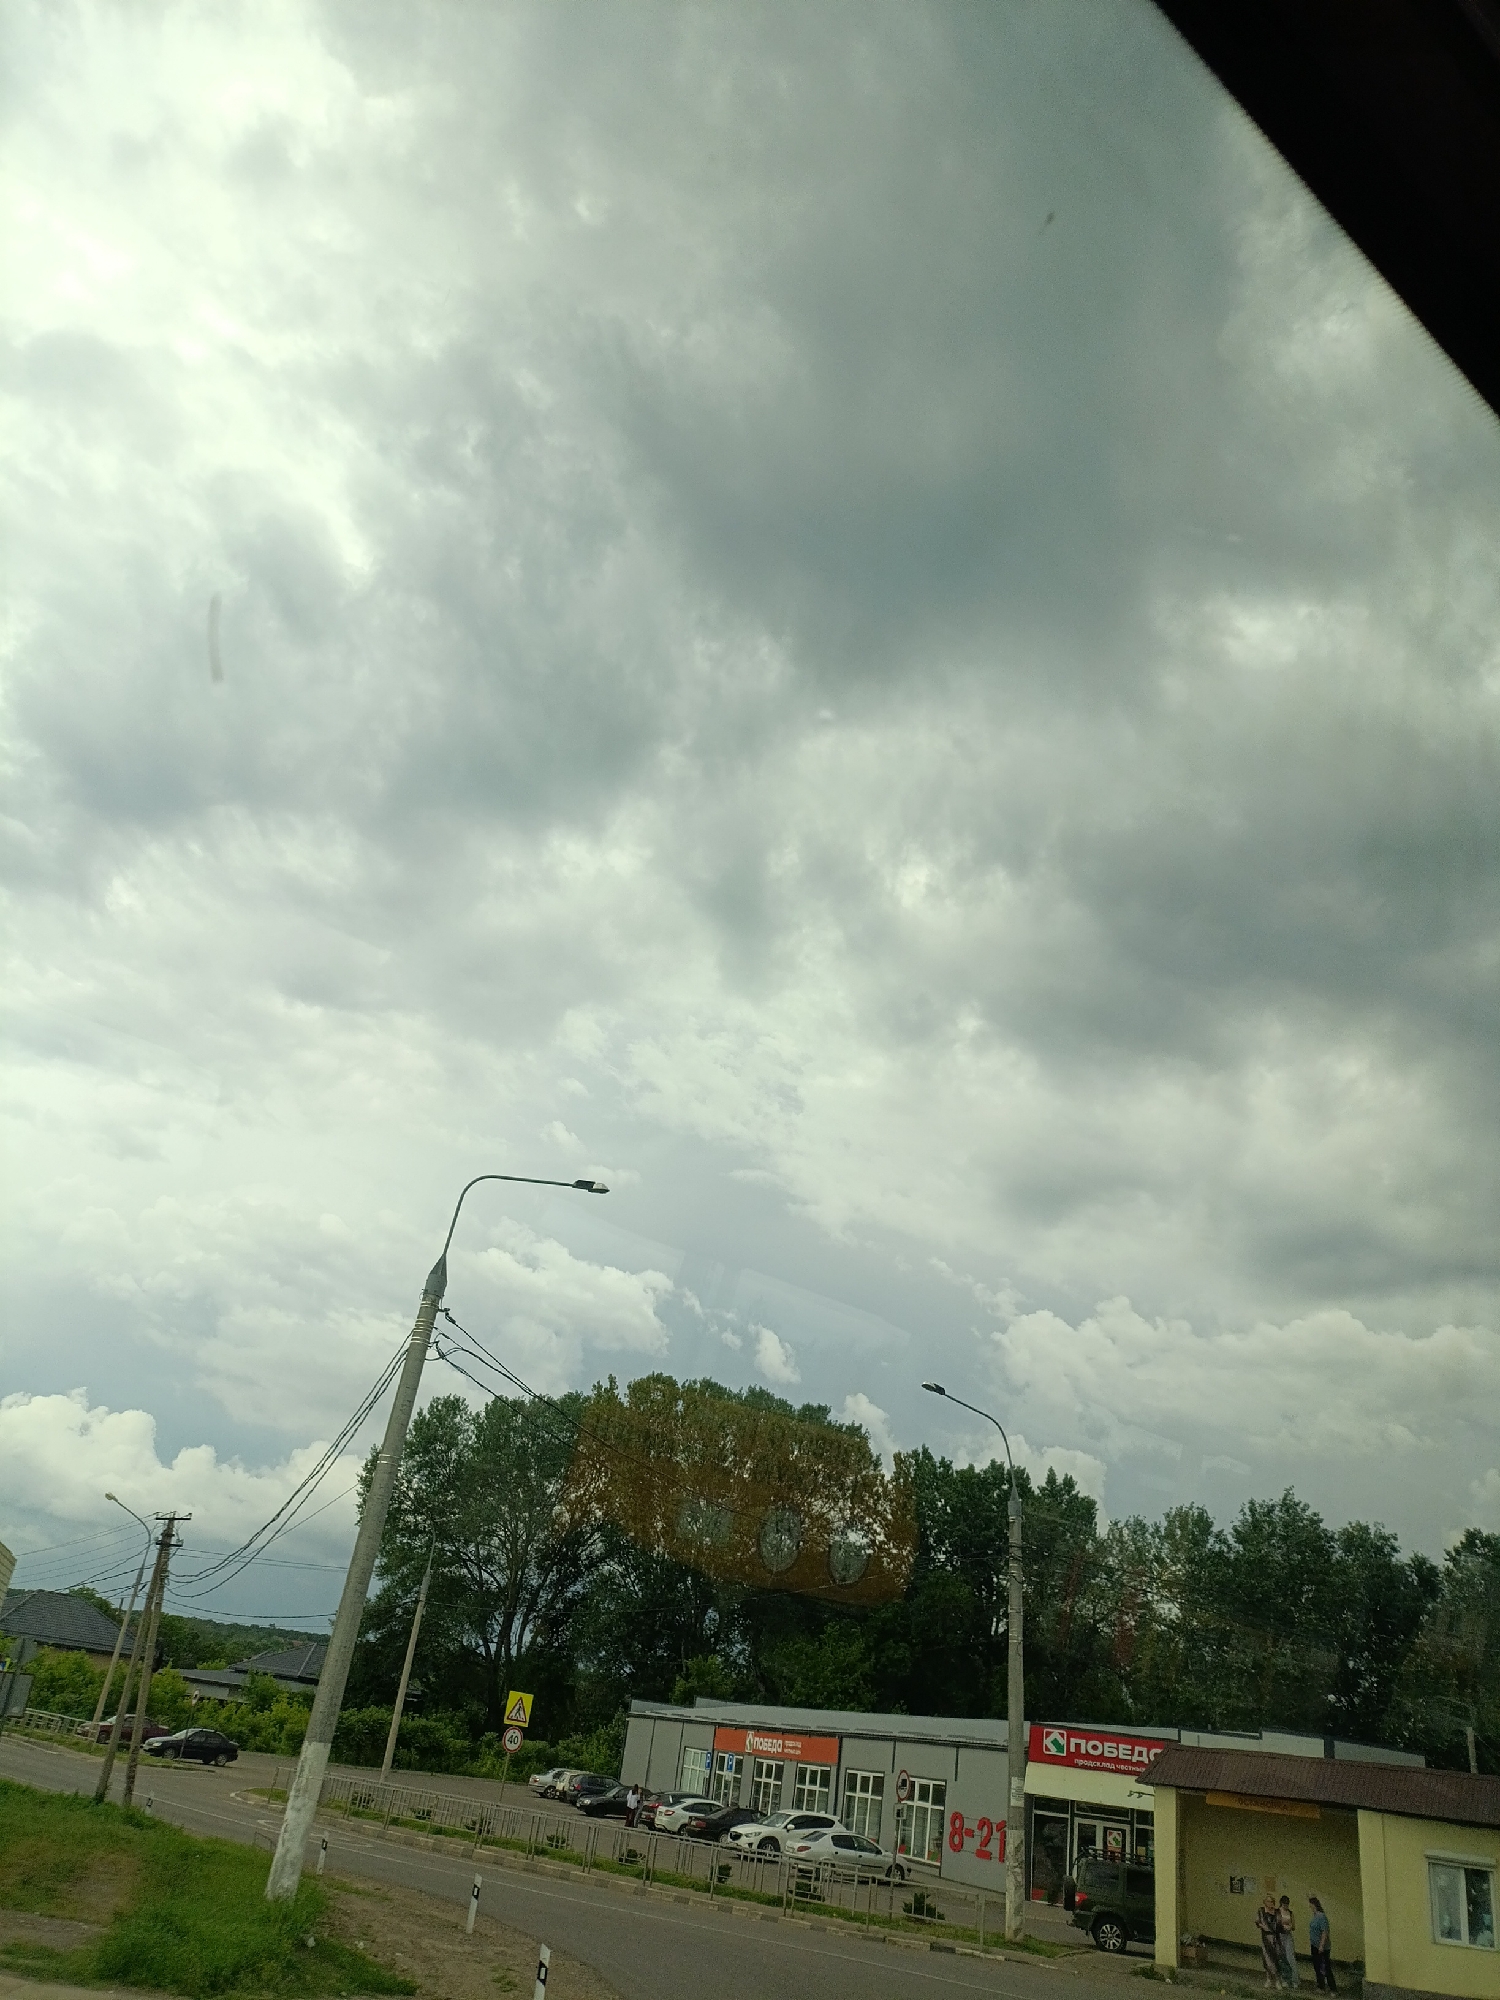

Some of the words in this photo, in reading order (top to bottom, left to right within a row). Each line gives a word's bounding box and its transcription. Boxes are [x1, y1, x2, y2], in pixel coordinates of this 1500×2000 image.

[507, 1734, 519, 1745] 40
[1074, 1758, 1116, 1771] продсклад
[948, 1811, 1007, 1863] 8-21
